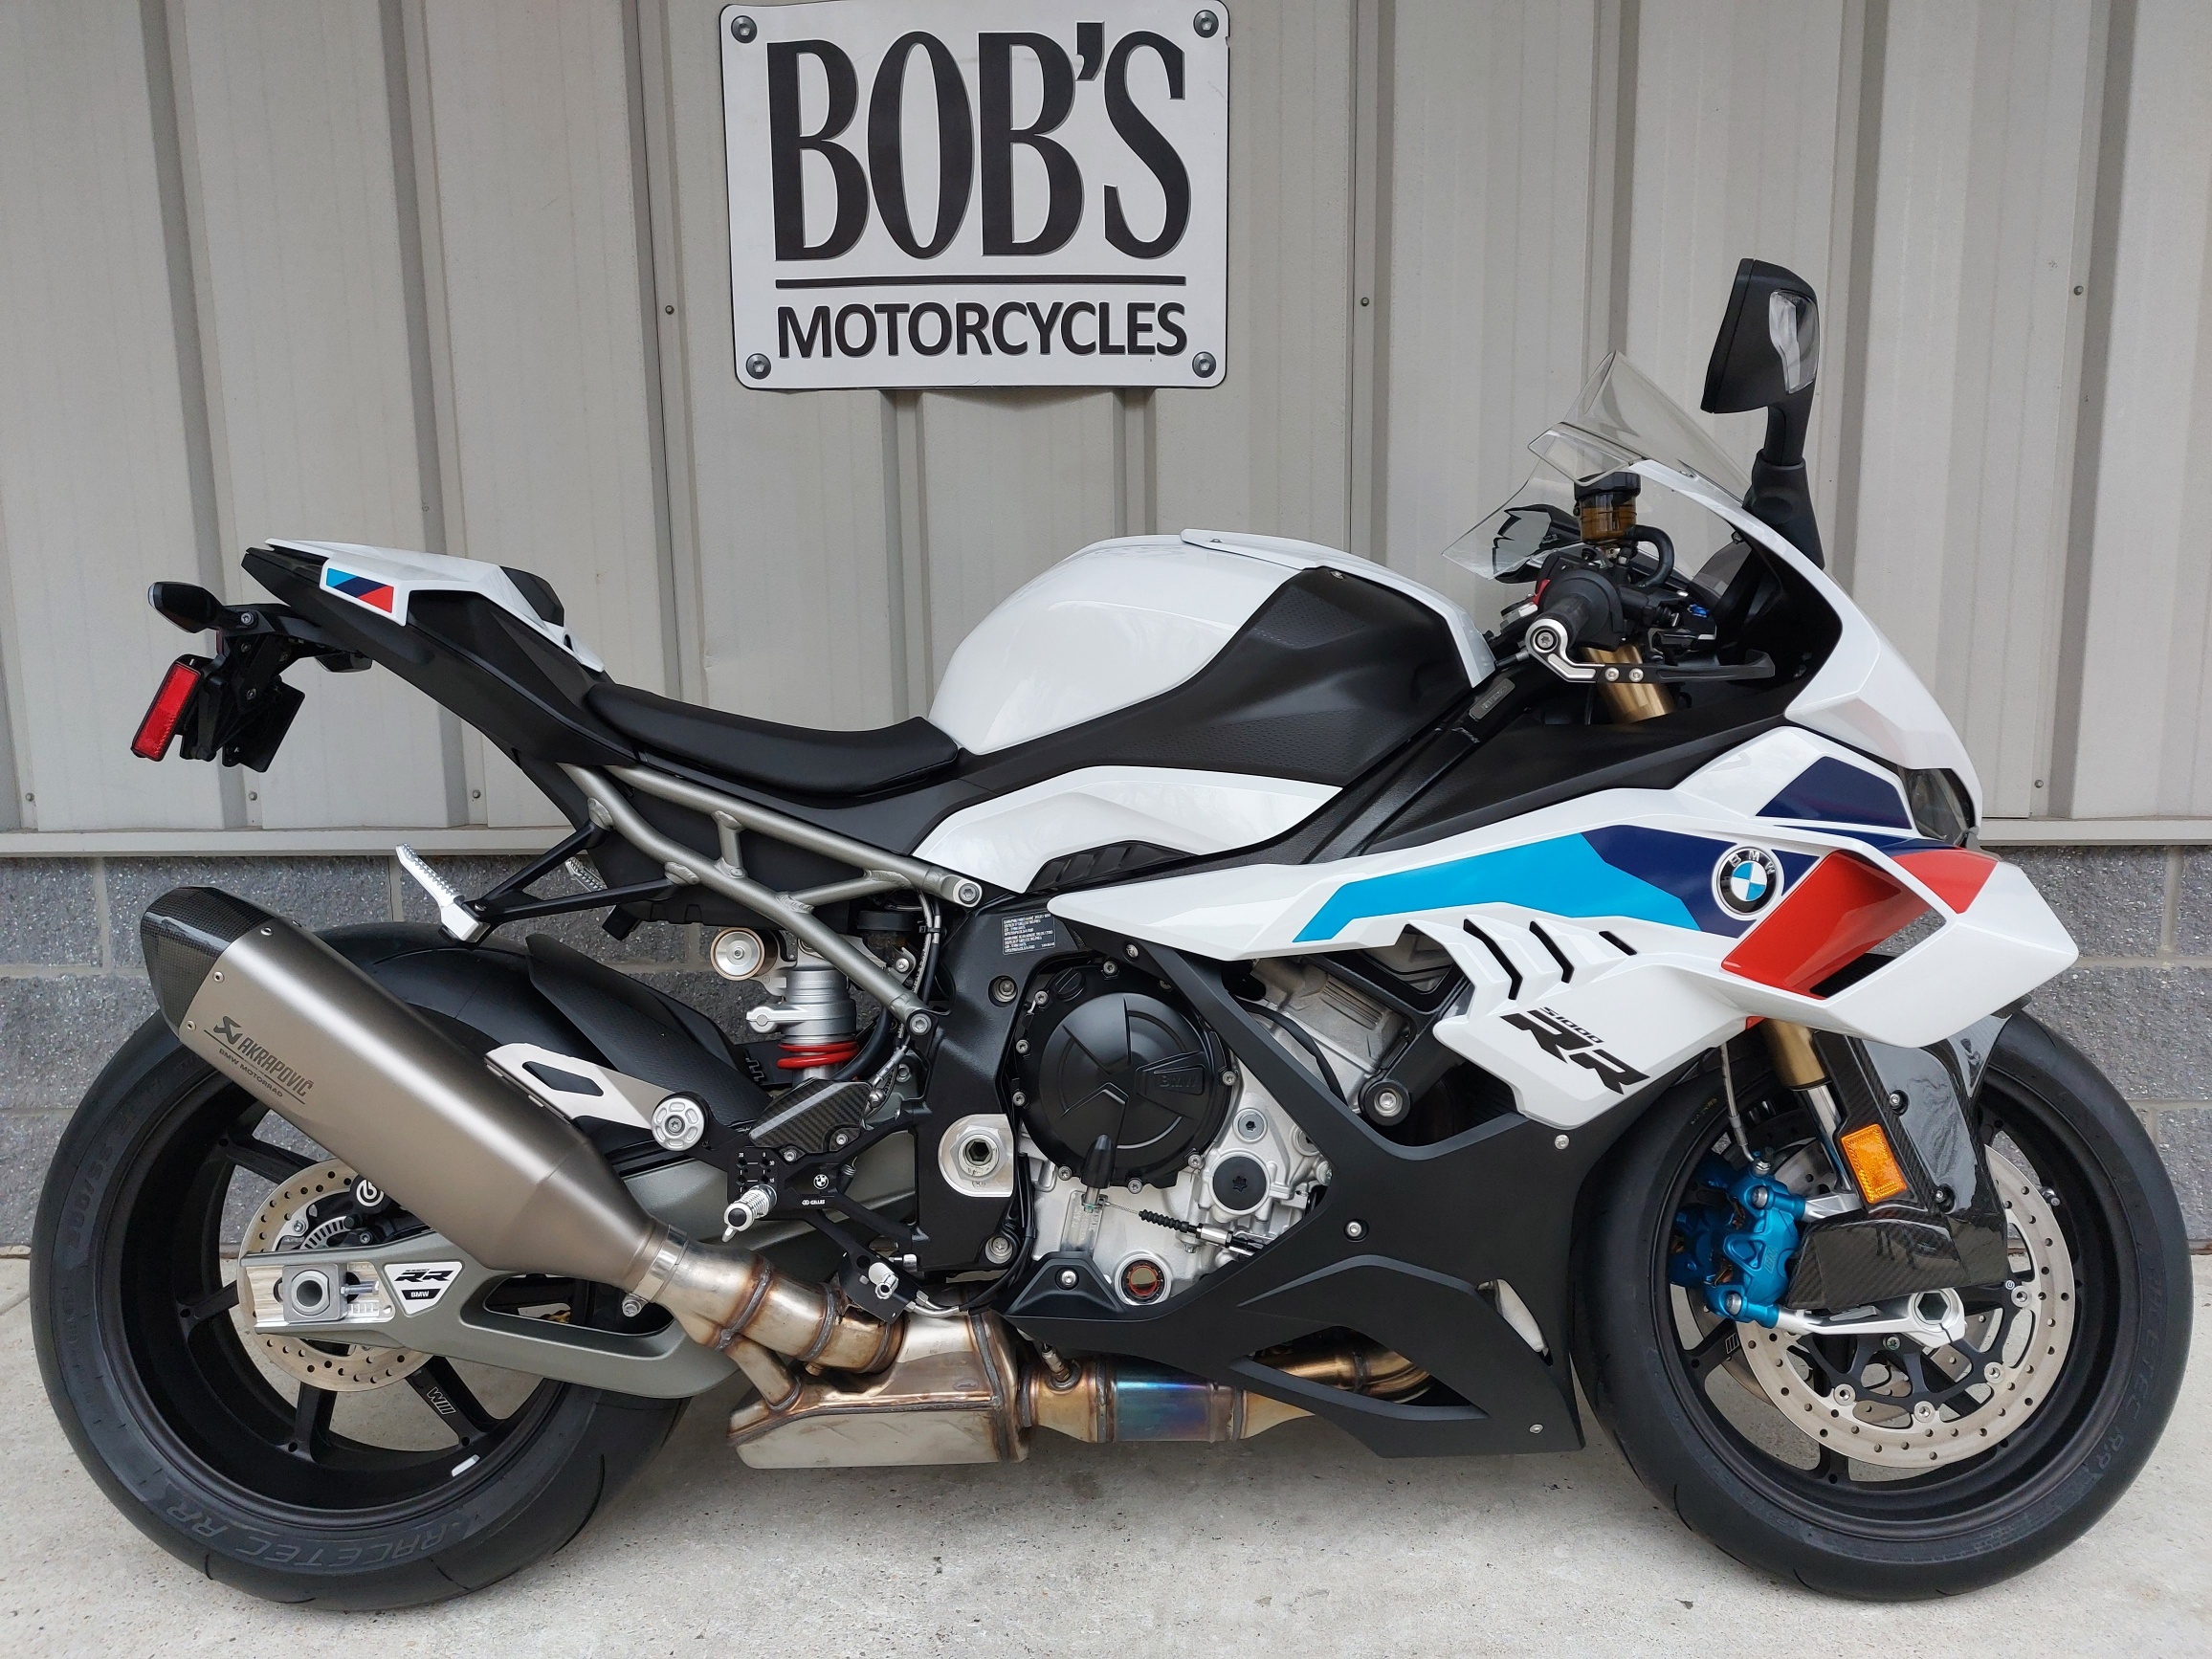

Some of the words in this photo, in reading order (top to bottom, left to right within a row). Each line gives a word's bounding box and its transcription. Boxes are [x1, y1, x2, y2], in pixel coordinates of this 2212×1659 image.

[766, 21, 1191, 260] BOB'S
[777, 301, 1188, 358] MOTORCYCLES
[1729, 850, 1776, 874] BMW
[219, 1048, 239, 1065] BMW
[240, 1063, 283, 1097] MOTORRAD
[1499, 1009, 1651, 1095] RR
[394, 1270, 453, 1283] RR
[410, 1290, 430, 1298] BMW
[164, 1502, 227, 1538] RR
